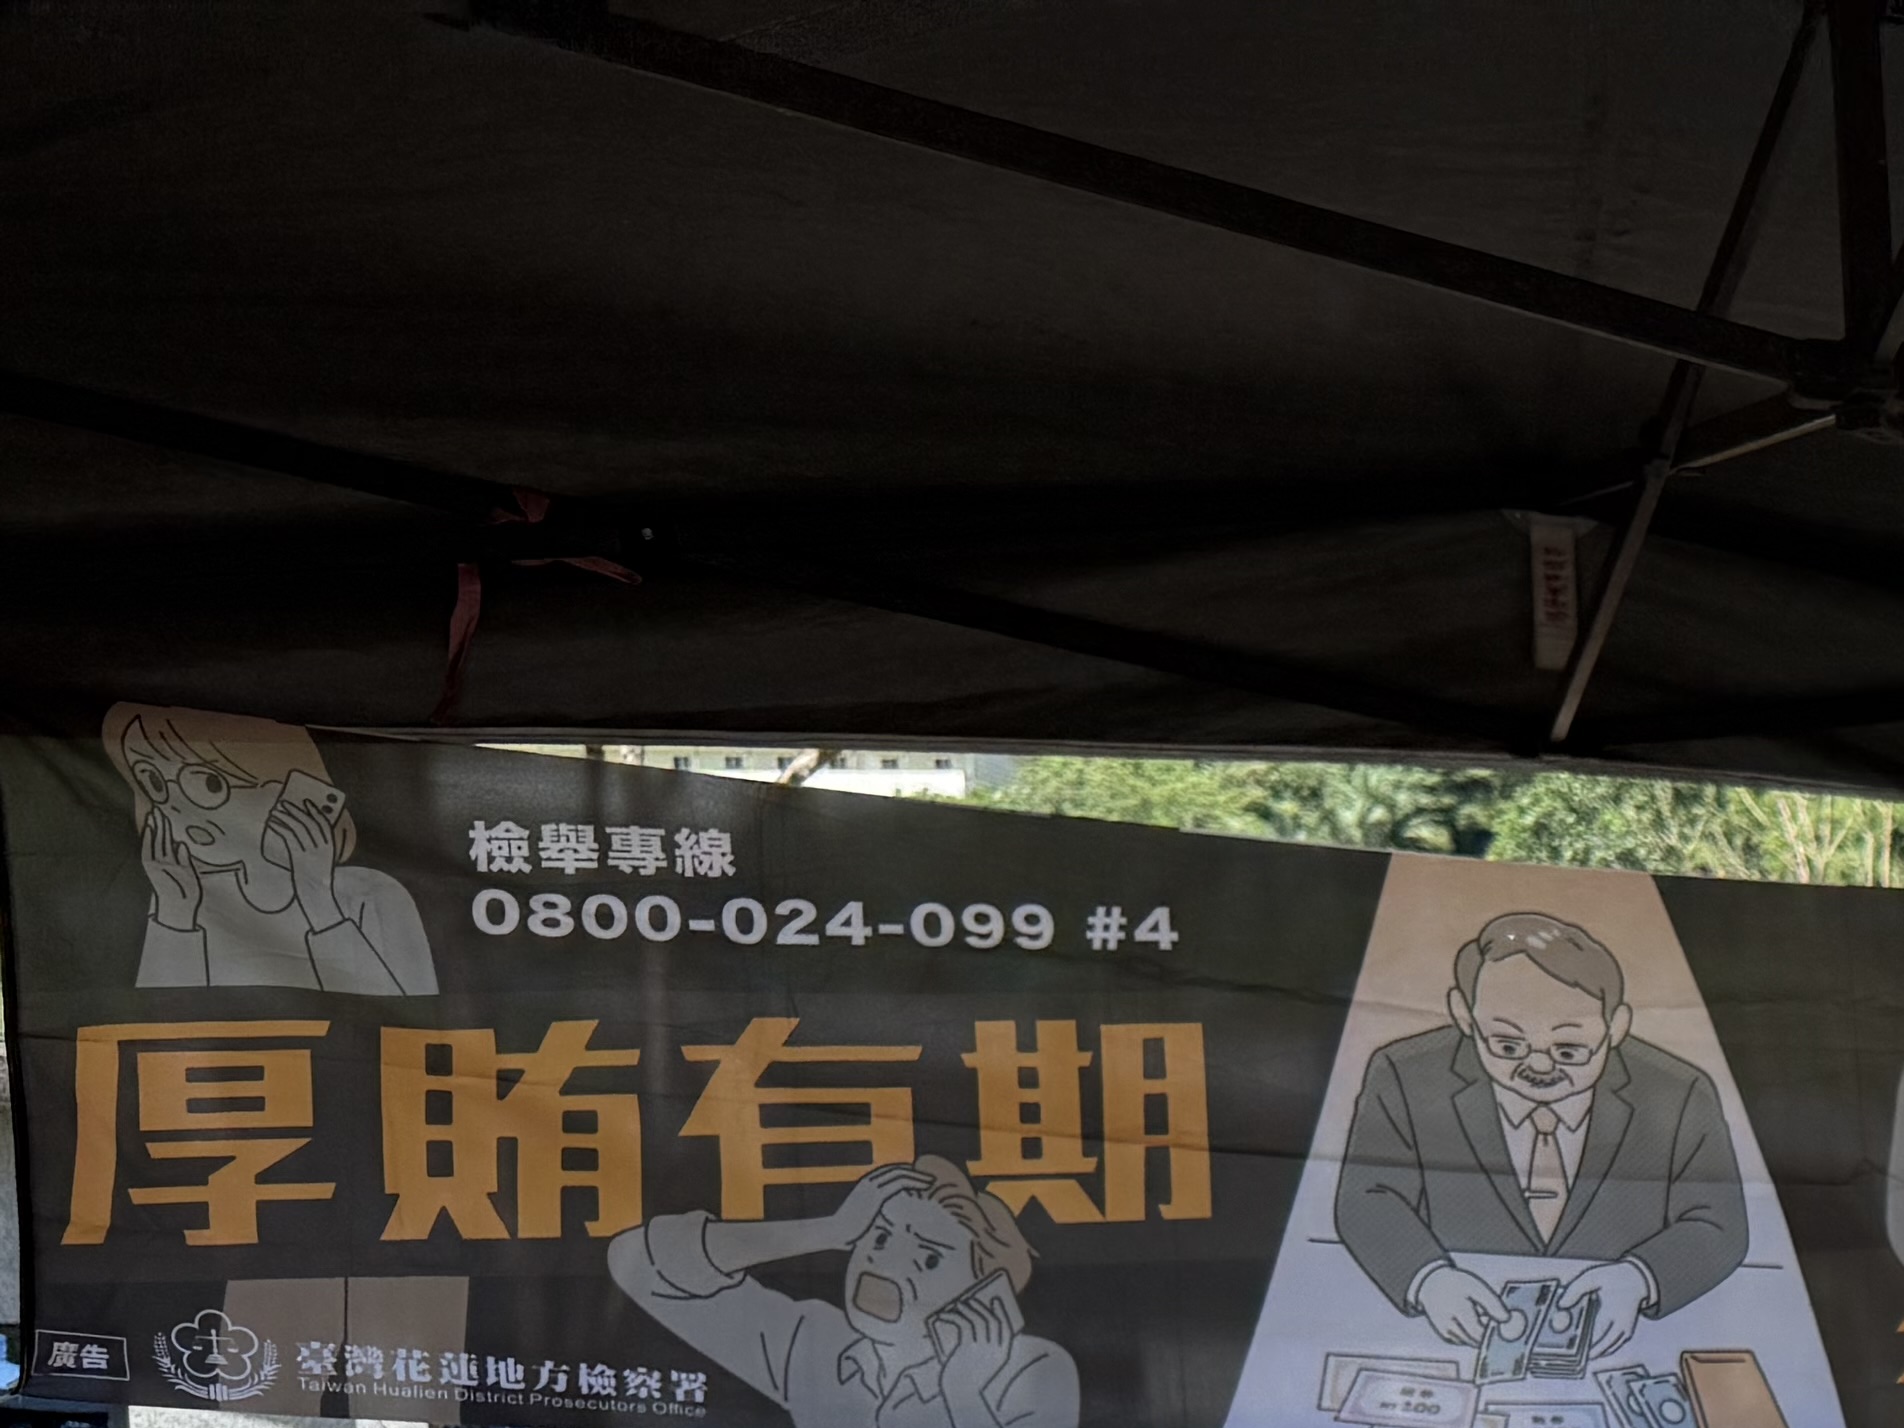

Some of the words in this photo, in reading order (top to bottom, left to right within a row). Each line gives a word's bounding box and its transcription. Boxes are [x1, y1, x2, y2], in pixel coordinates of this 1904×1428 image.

[468, 819, 737, 879] 檢舉專線
[469, 888, 1057, 952] 0800-024-099
[1084, 902, 1180, 953] #4
[60, 1016, 1215, 1247] 厚賄有期
[46, 1339, 111, 1371] 廣告
[296, 1339, 709, 1404] 臺灣花蓮地方檢察署
[299, 1377, 367, 1396] Taiwan
[373, 1380, 445, 1400] Hualien
[453, 1386, 525, 1405] District
[529, 1391, 647, 1416] Prosecutors
[652, 1400, 708, 1419] Office
